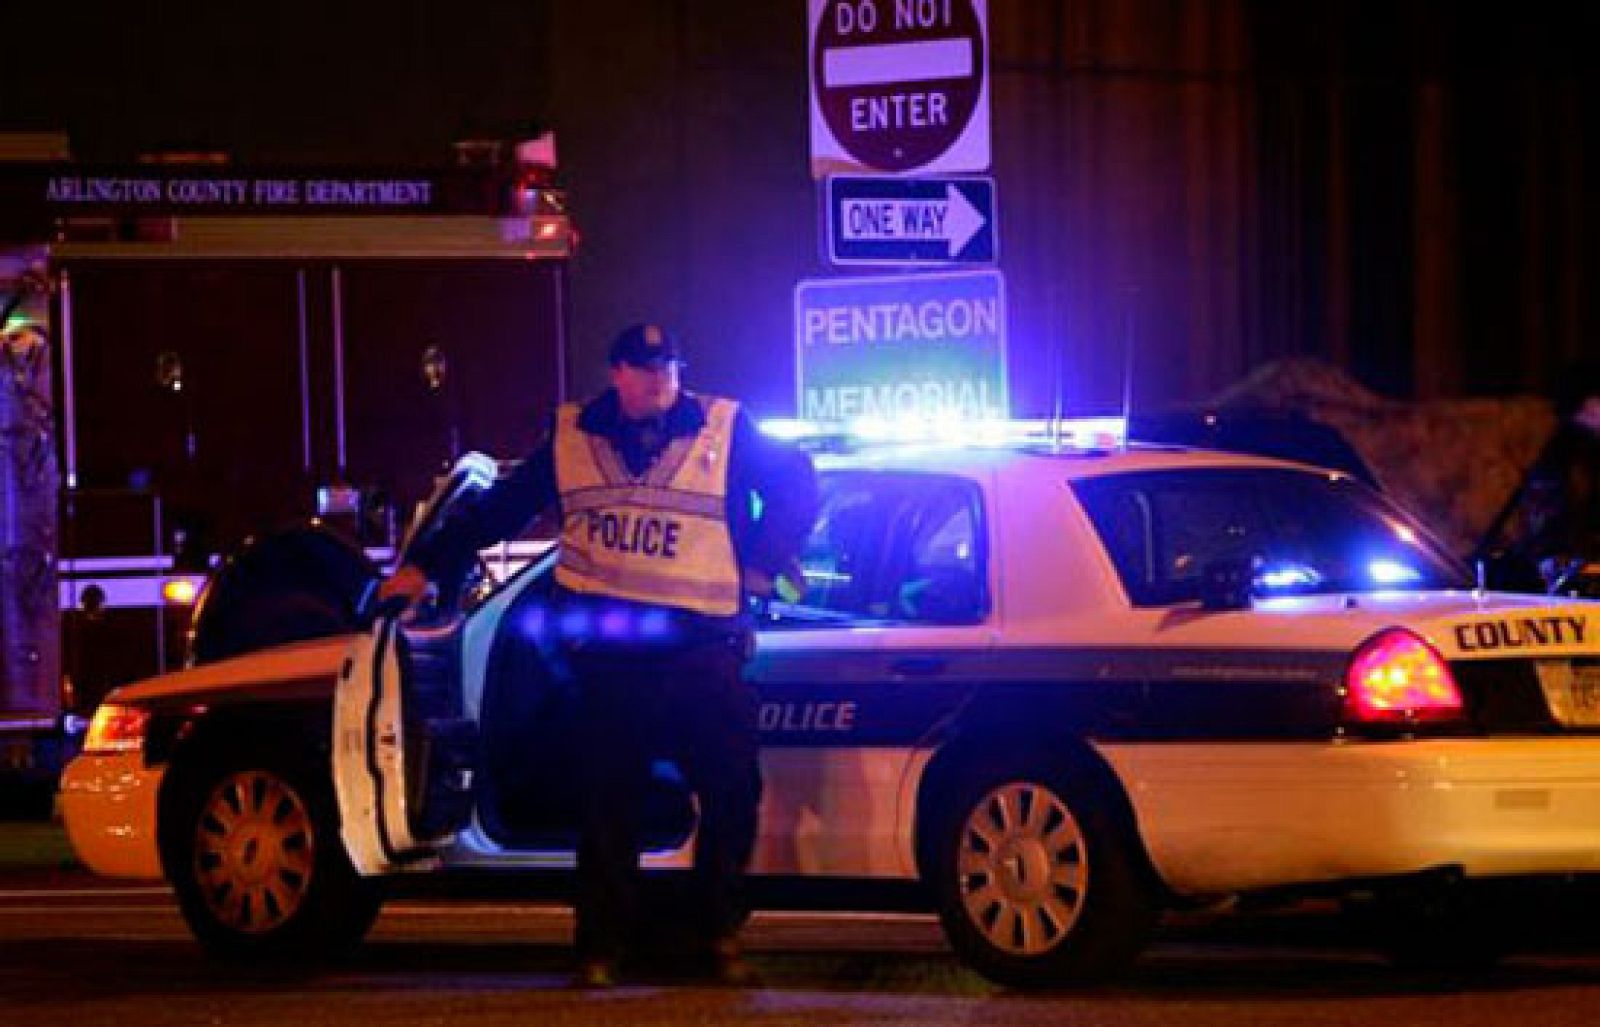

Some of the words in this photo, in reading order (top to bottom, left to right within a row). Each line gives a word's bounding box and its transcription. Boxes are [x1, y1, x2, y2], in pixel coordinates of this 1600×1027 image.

[836, 2, 877, 35] DO
[895, 0, 956, 30] NOT
[851, 92, 949, 132] ENTER
[46, 177, 162, 204] ARLINGTON
[167, 178, 248, 204] COUNTY
[254, 178, 301, 205] FIRE
[304, 178, 432, 206] DEPARTMENT
[850, 202, 895, 236] ONE
[900, 202, 948, 234] WAY
[804, 298, 998, 345] PENTAGON
[806, 378, 1000, 421] MEMORIAL
[586, 508, 681, 559] POLICE
[1454, 615, 1586, 652] COUNTY
[757, 700, 857, 732] OLICE
